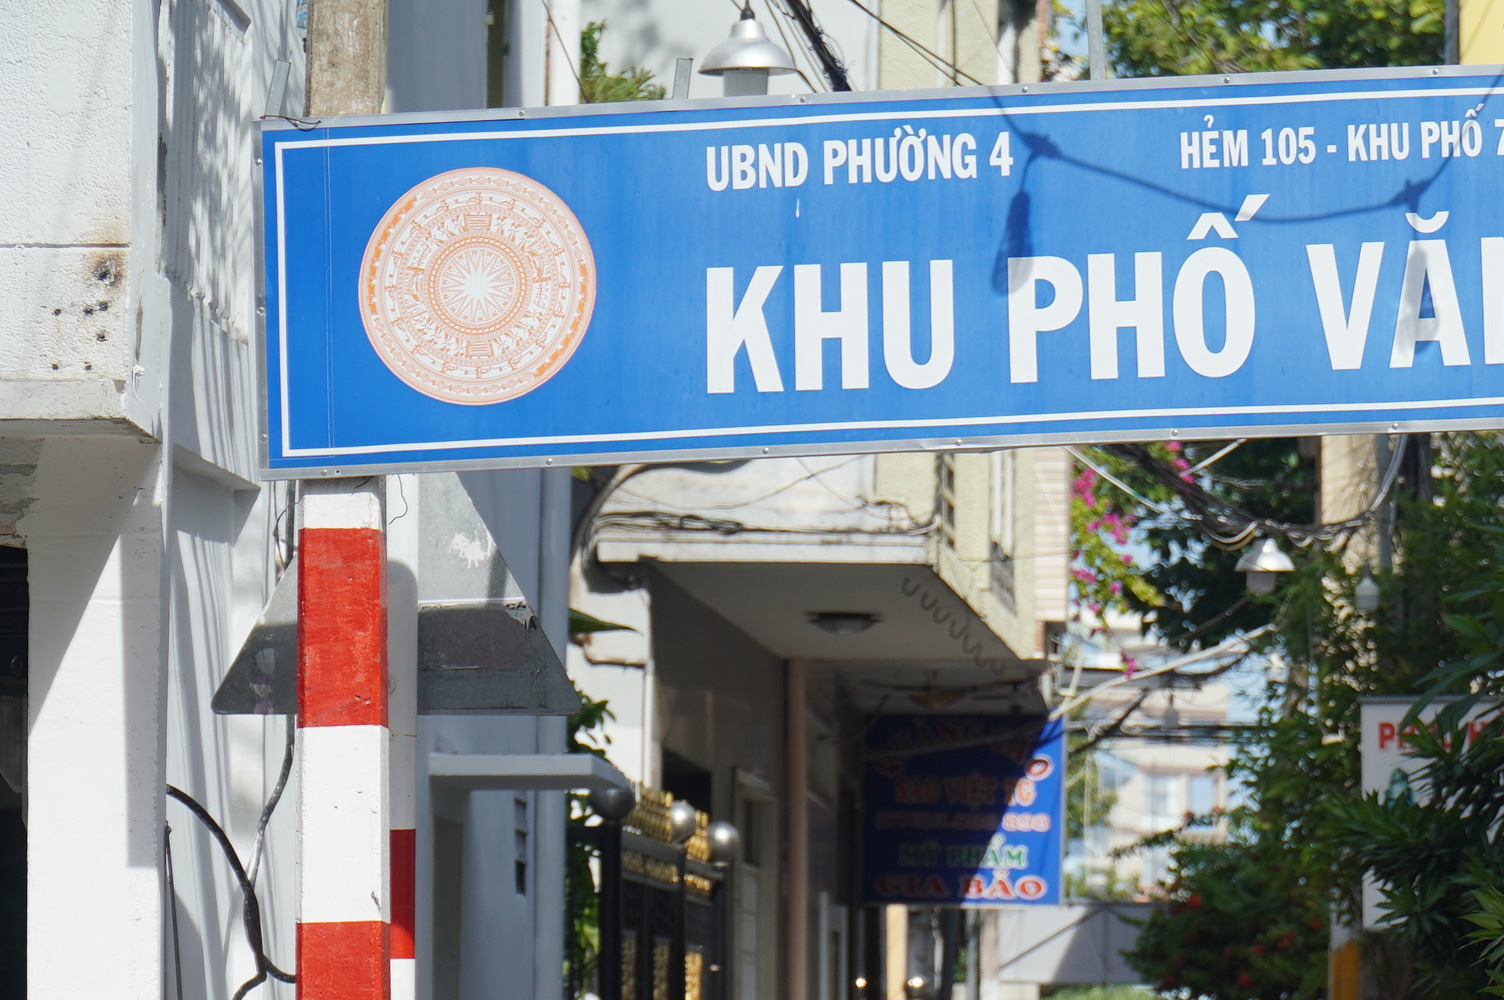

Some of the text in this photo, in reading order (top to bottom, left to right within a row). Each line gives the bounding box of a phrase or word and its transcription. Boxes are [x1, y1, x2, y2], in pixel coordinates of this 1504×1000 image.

[706, 125, 1013, 191] UBND PHƯỜNG 4
[1180, 114, 1249, 169] HẺM
[1261, 126, 1316, 166] 105
[1347, 123, 1410, 162] KHU
[1421, 103, 1486, 159] PHỐ
[706, 259, 955, 394] KHU
[1008, 194, 1270, 383] PHỐ
